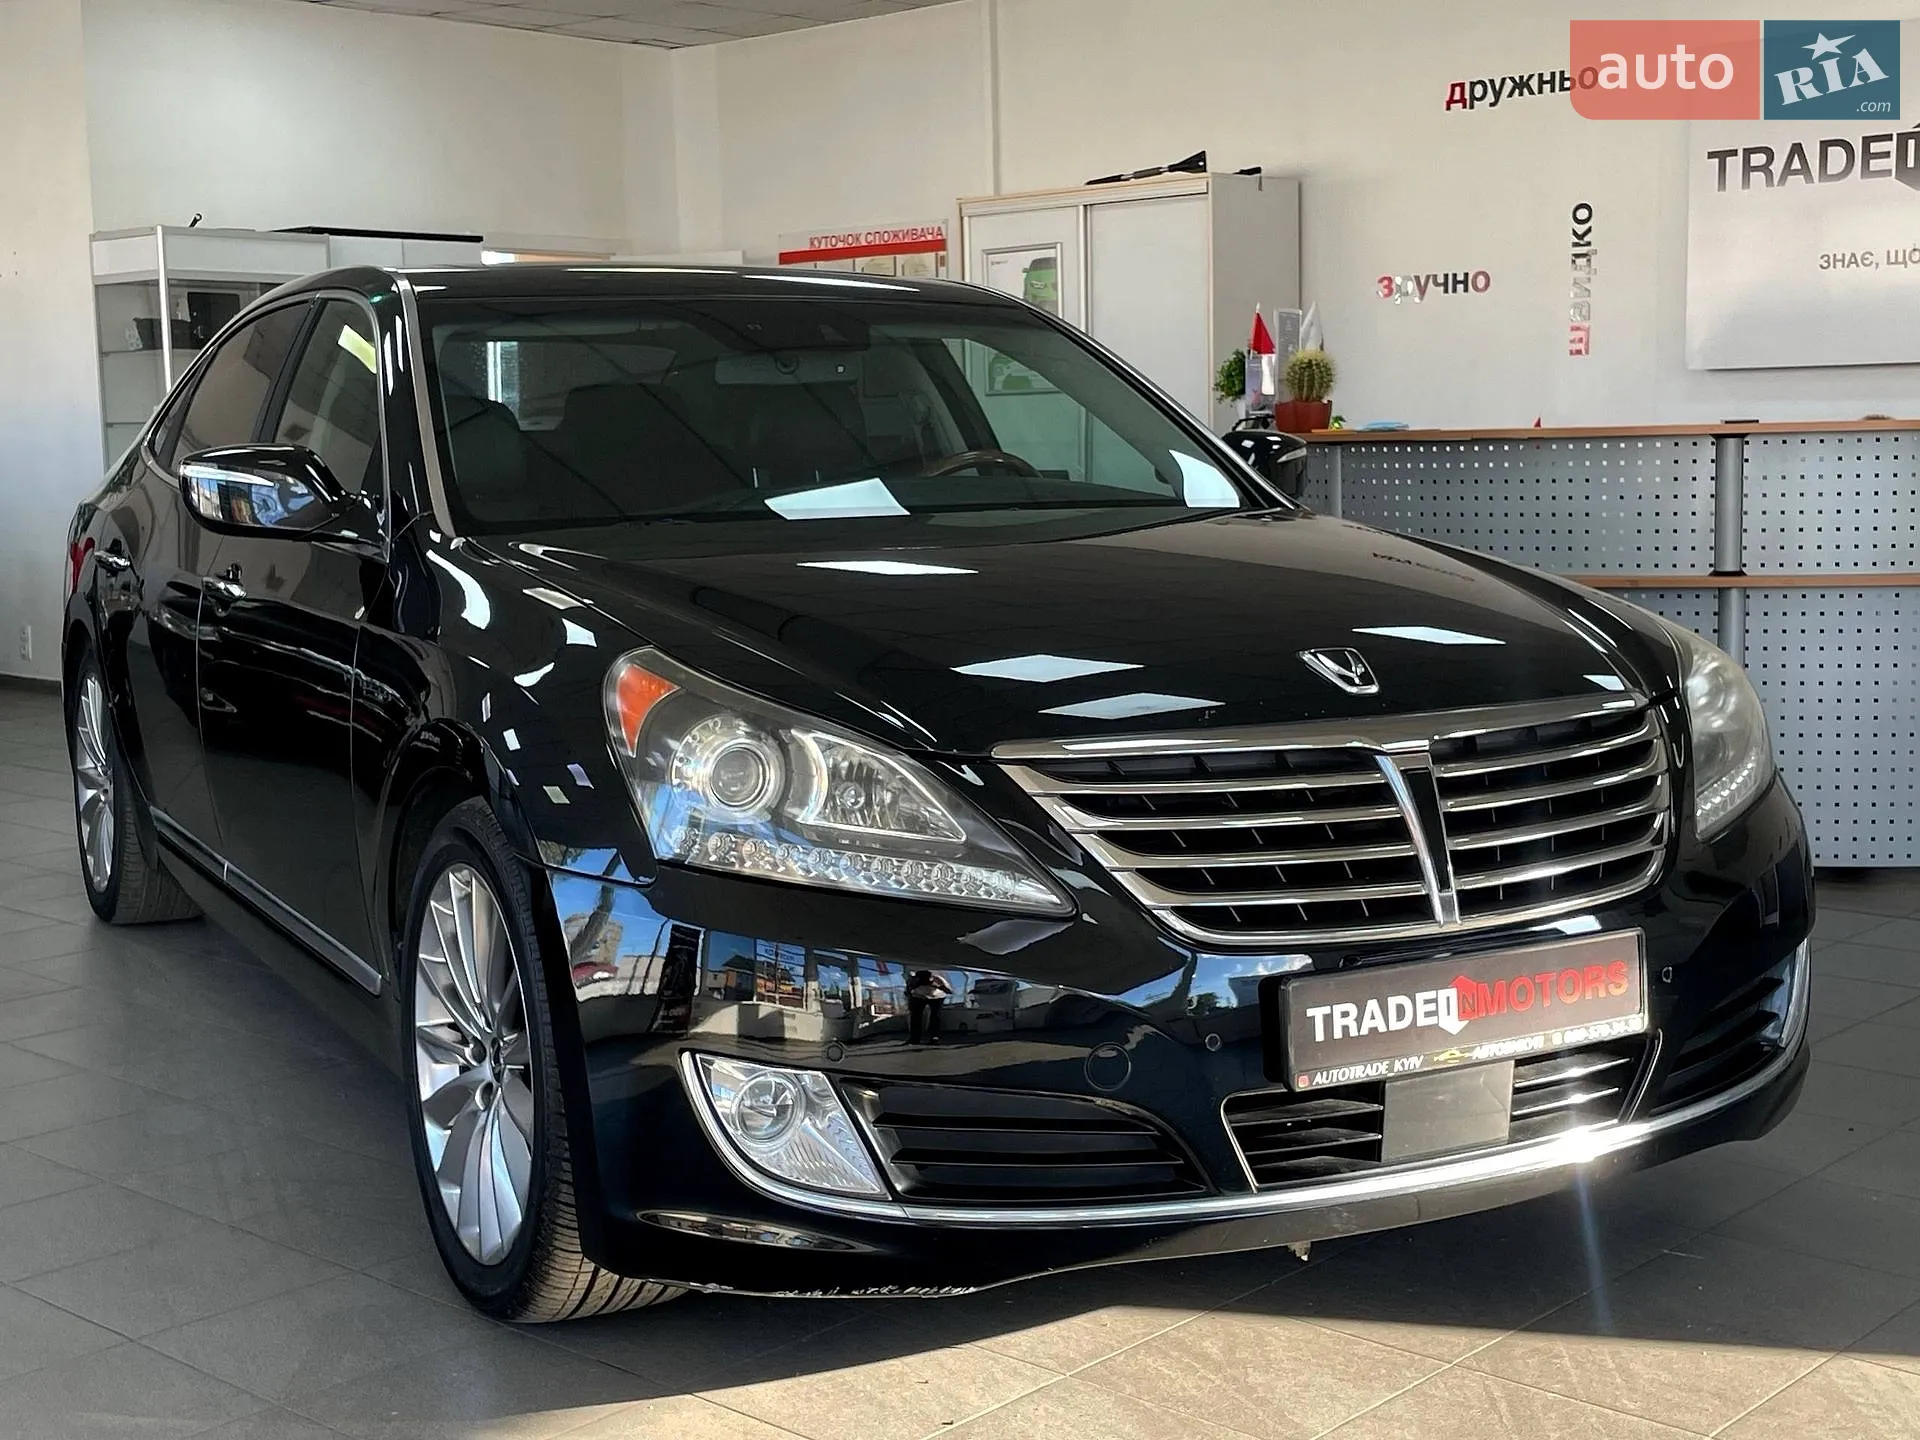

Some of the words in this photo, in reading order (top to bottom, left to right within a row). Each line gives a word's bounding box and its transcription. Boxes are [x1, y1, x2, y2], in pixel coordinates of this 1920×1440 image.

[1445, 66, 1599, 111] дружньо
[809, 233, 862, 249] КУТОЧОК
[864, 225, 944, 244] СПОЖИВАЧА
[1819, 251, 1879, 271] ЗНАЄ,
